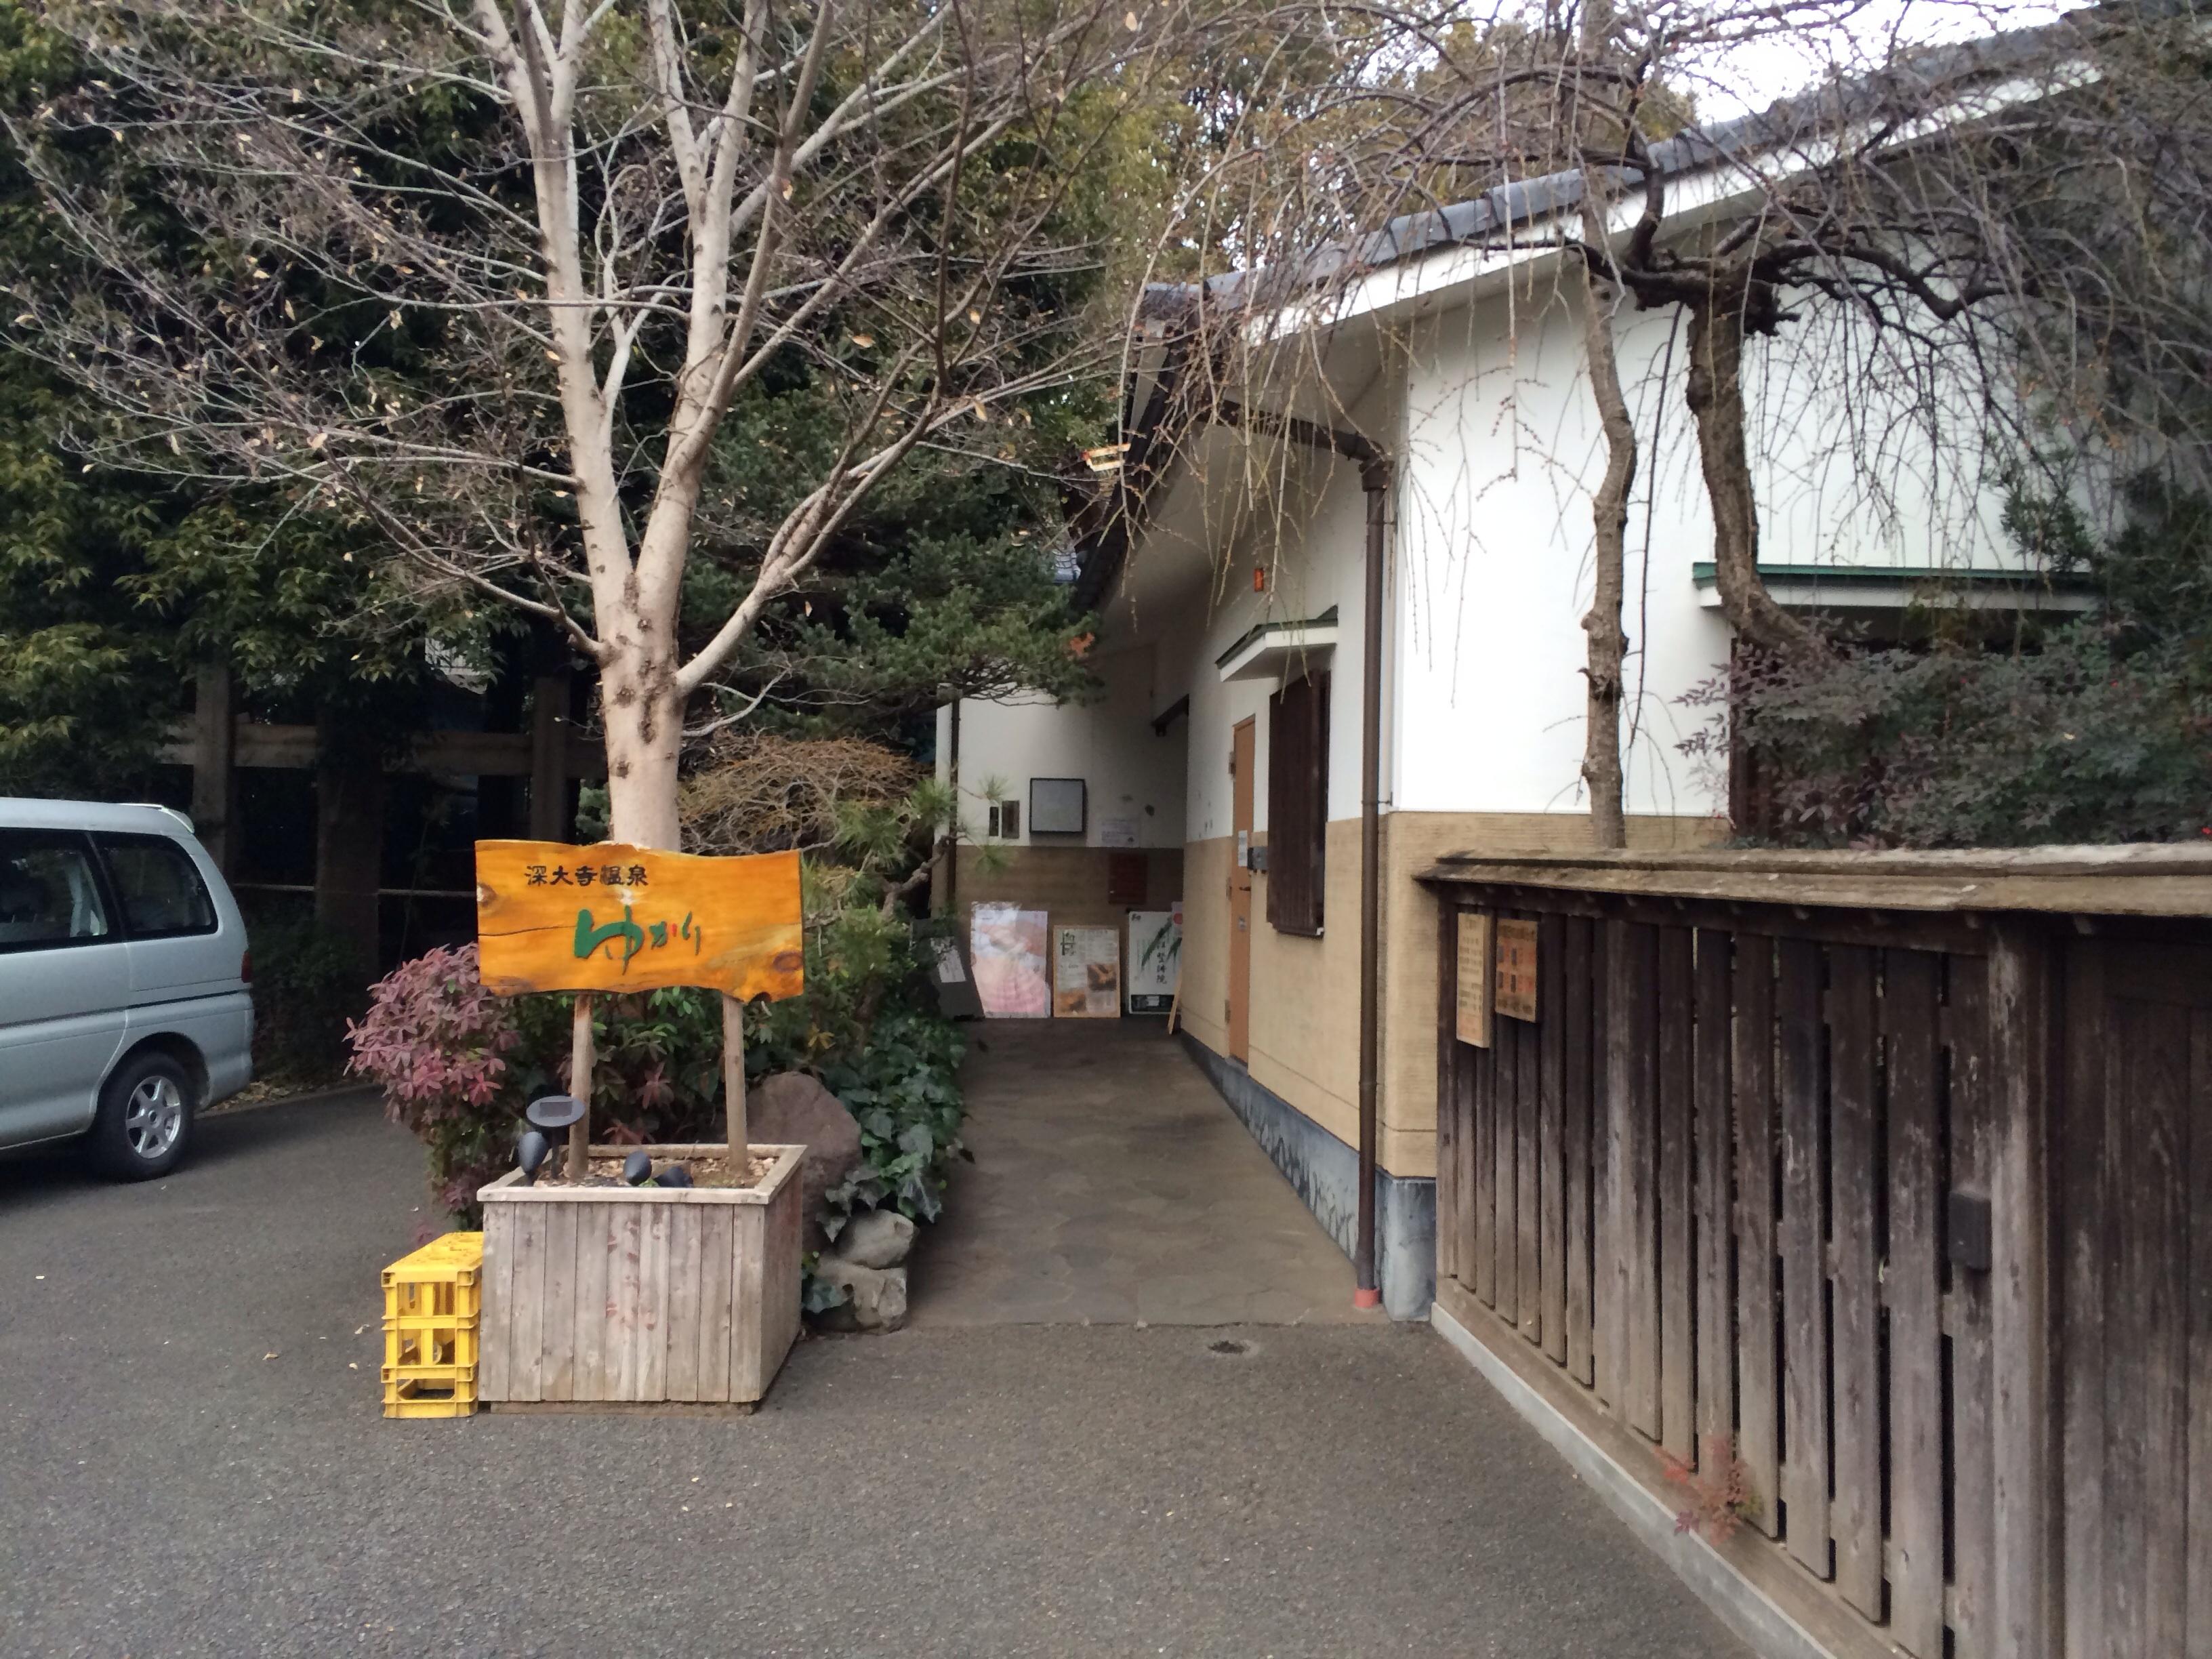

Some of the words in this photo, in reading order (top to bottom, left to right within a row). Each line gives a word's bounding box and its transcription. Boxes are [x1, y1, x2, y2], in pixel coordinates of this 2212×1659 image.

[524, 864, 649, 886] 深大寺温泉
[574, 905, 701, 975] ゆかり
